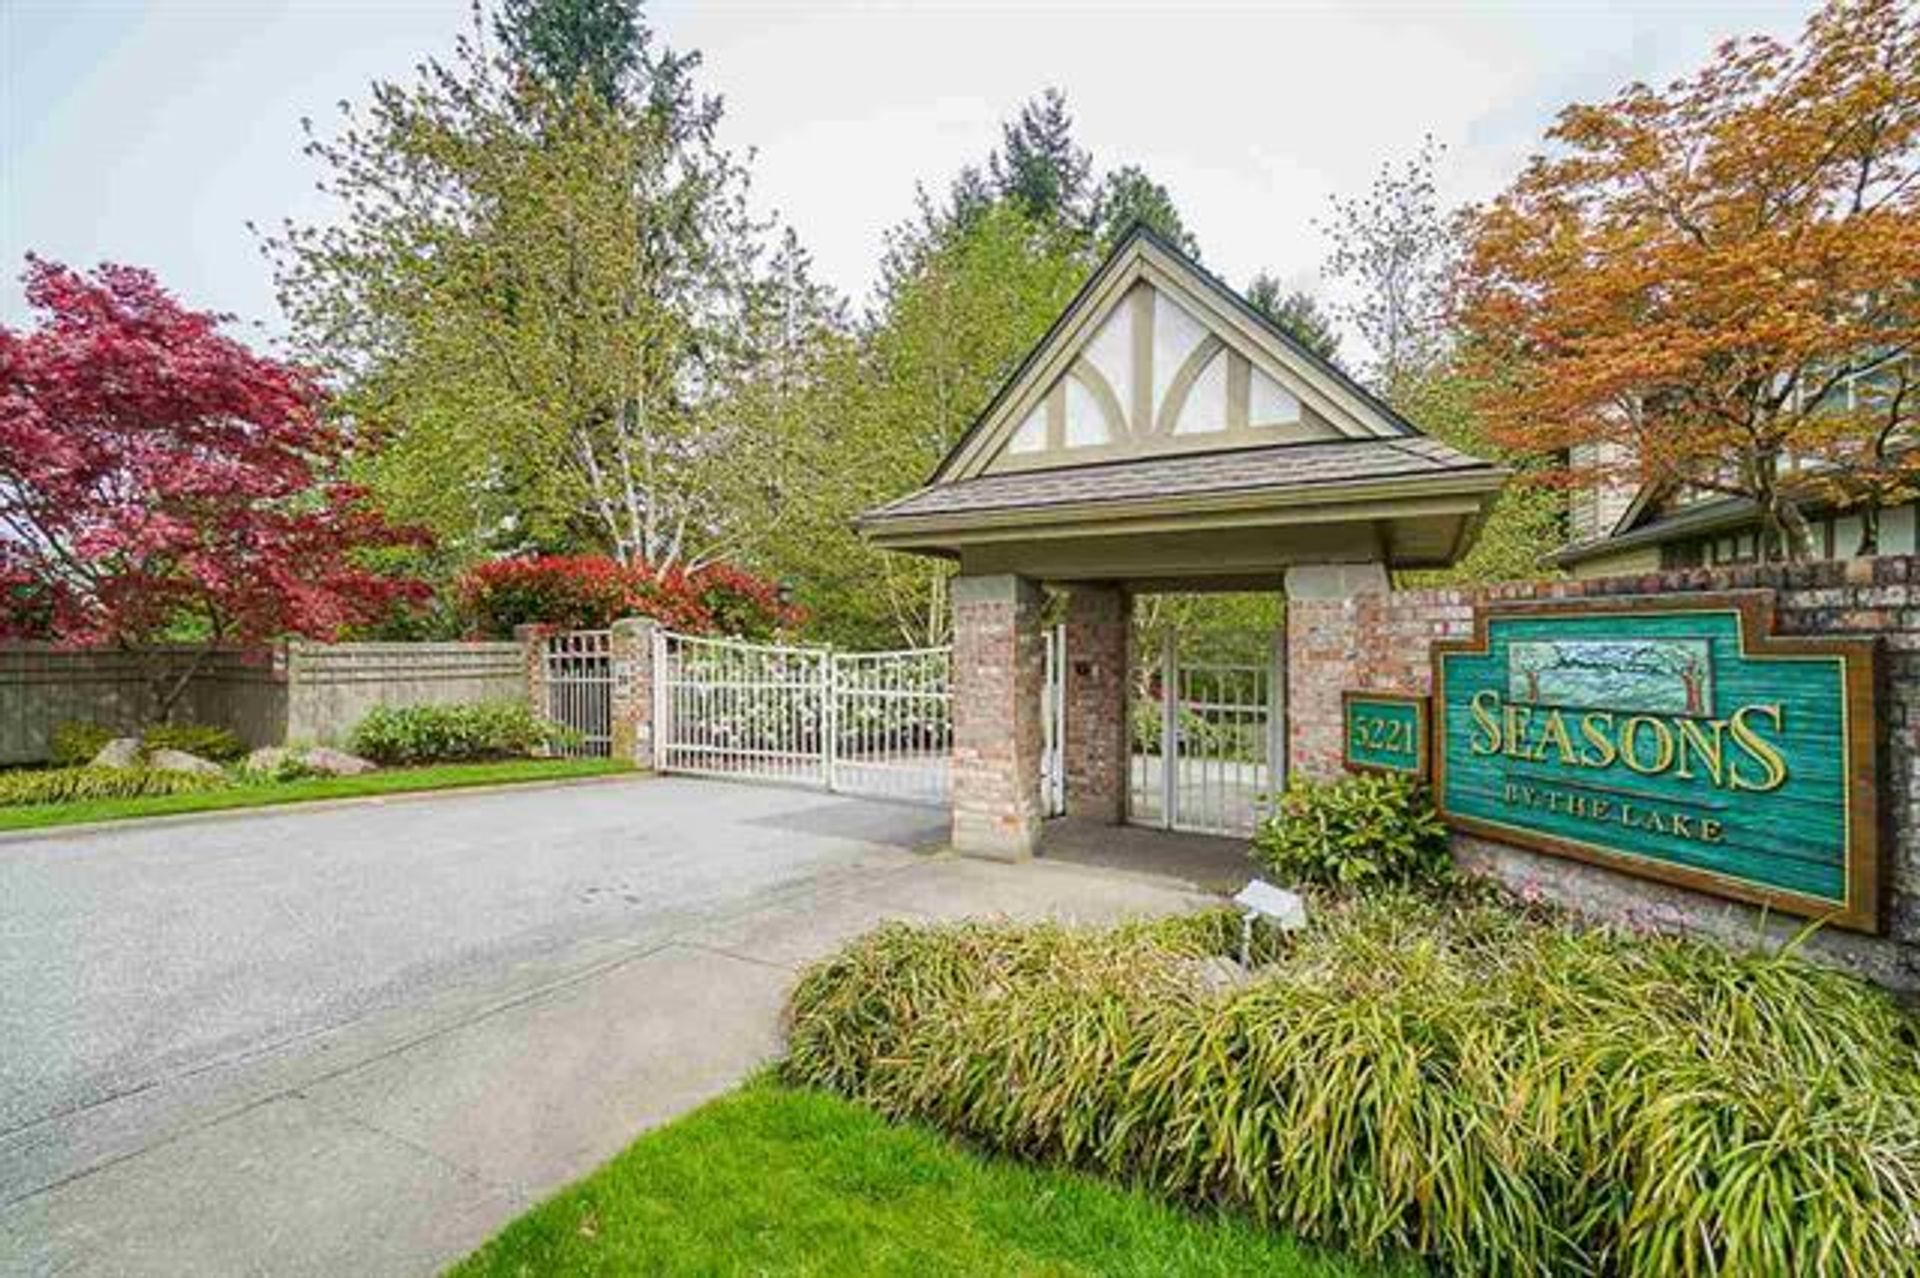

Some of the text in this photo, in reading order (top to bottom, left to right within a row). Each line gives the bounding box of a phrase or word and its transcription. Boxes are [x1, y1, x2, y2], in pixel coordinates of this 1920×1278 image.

[1354, 716, 1413, 753] 5221
[1470, 689, 1787, 791] SEASONS
[1505, 783, 1723, 842] BY THE LAKE
